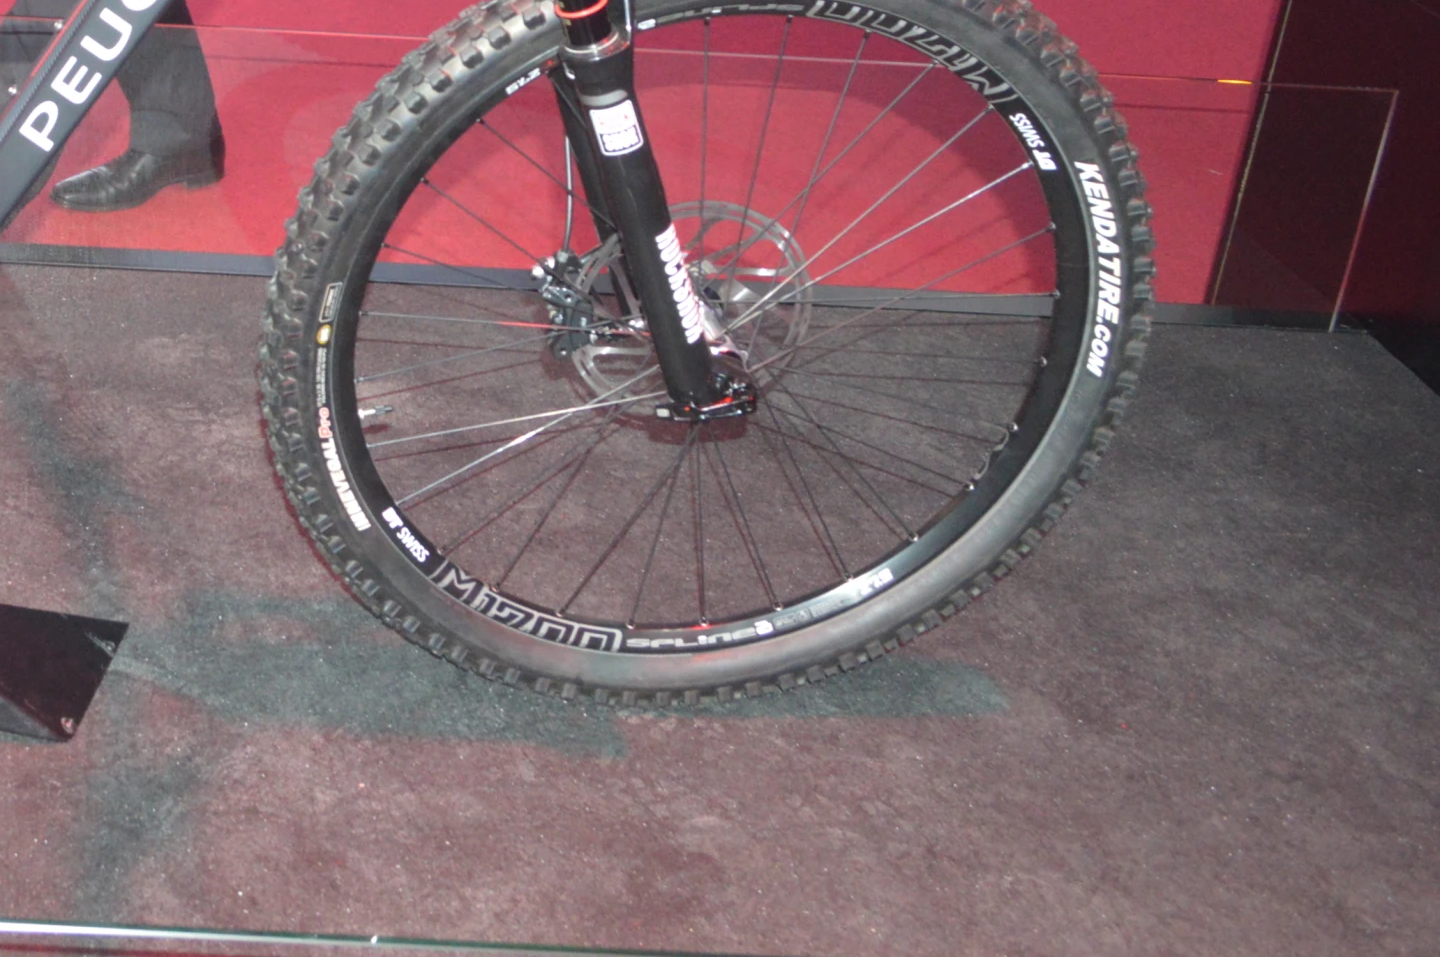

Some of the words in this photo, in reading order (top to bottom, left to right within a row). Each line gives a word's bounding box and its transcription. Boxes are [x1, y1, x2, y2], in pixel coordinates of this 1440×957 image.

[1009, 112, 1045, 151] SWISS
[1074, 161, 1122, 378] KENDATIRE.COM
[397, 526, 430, 563] SWISS
